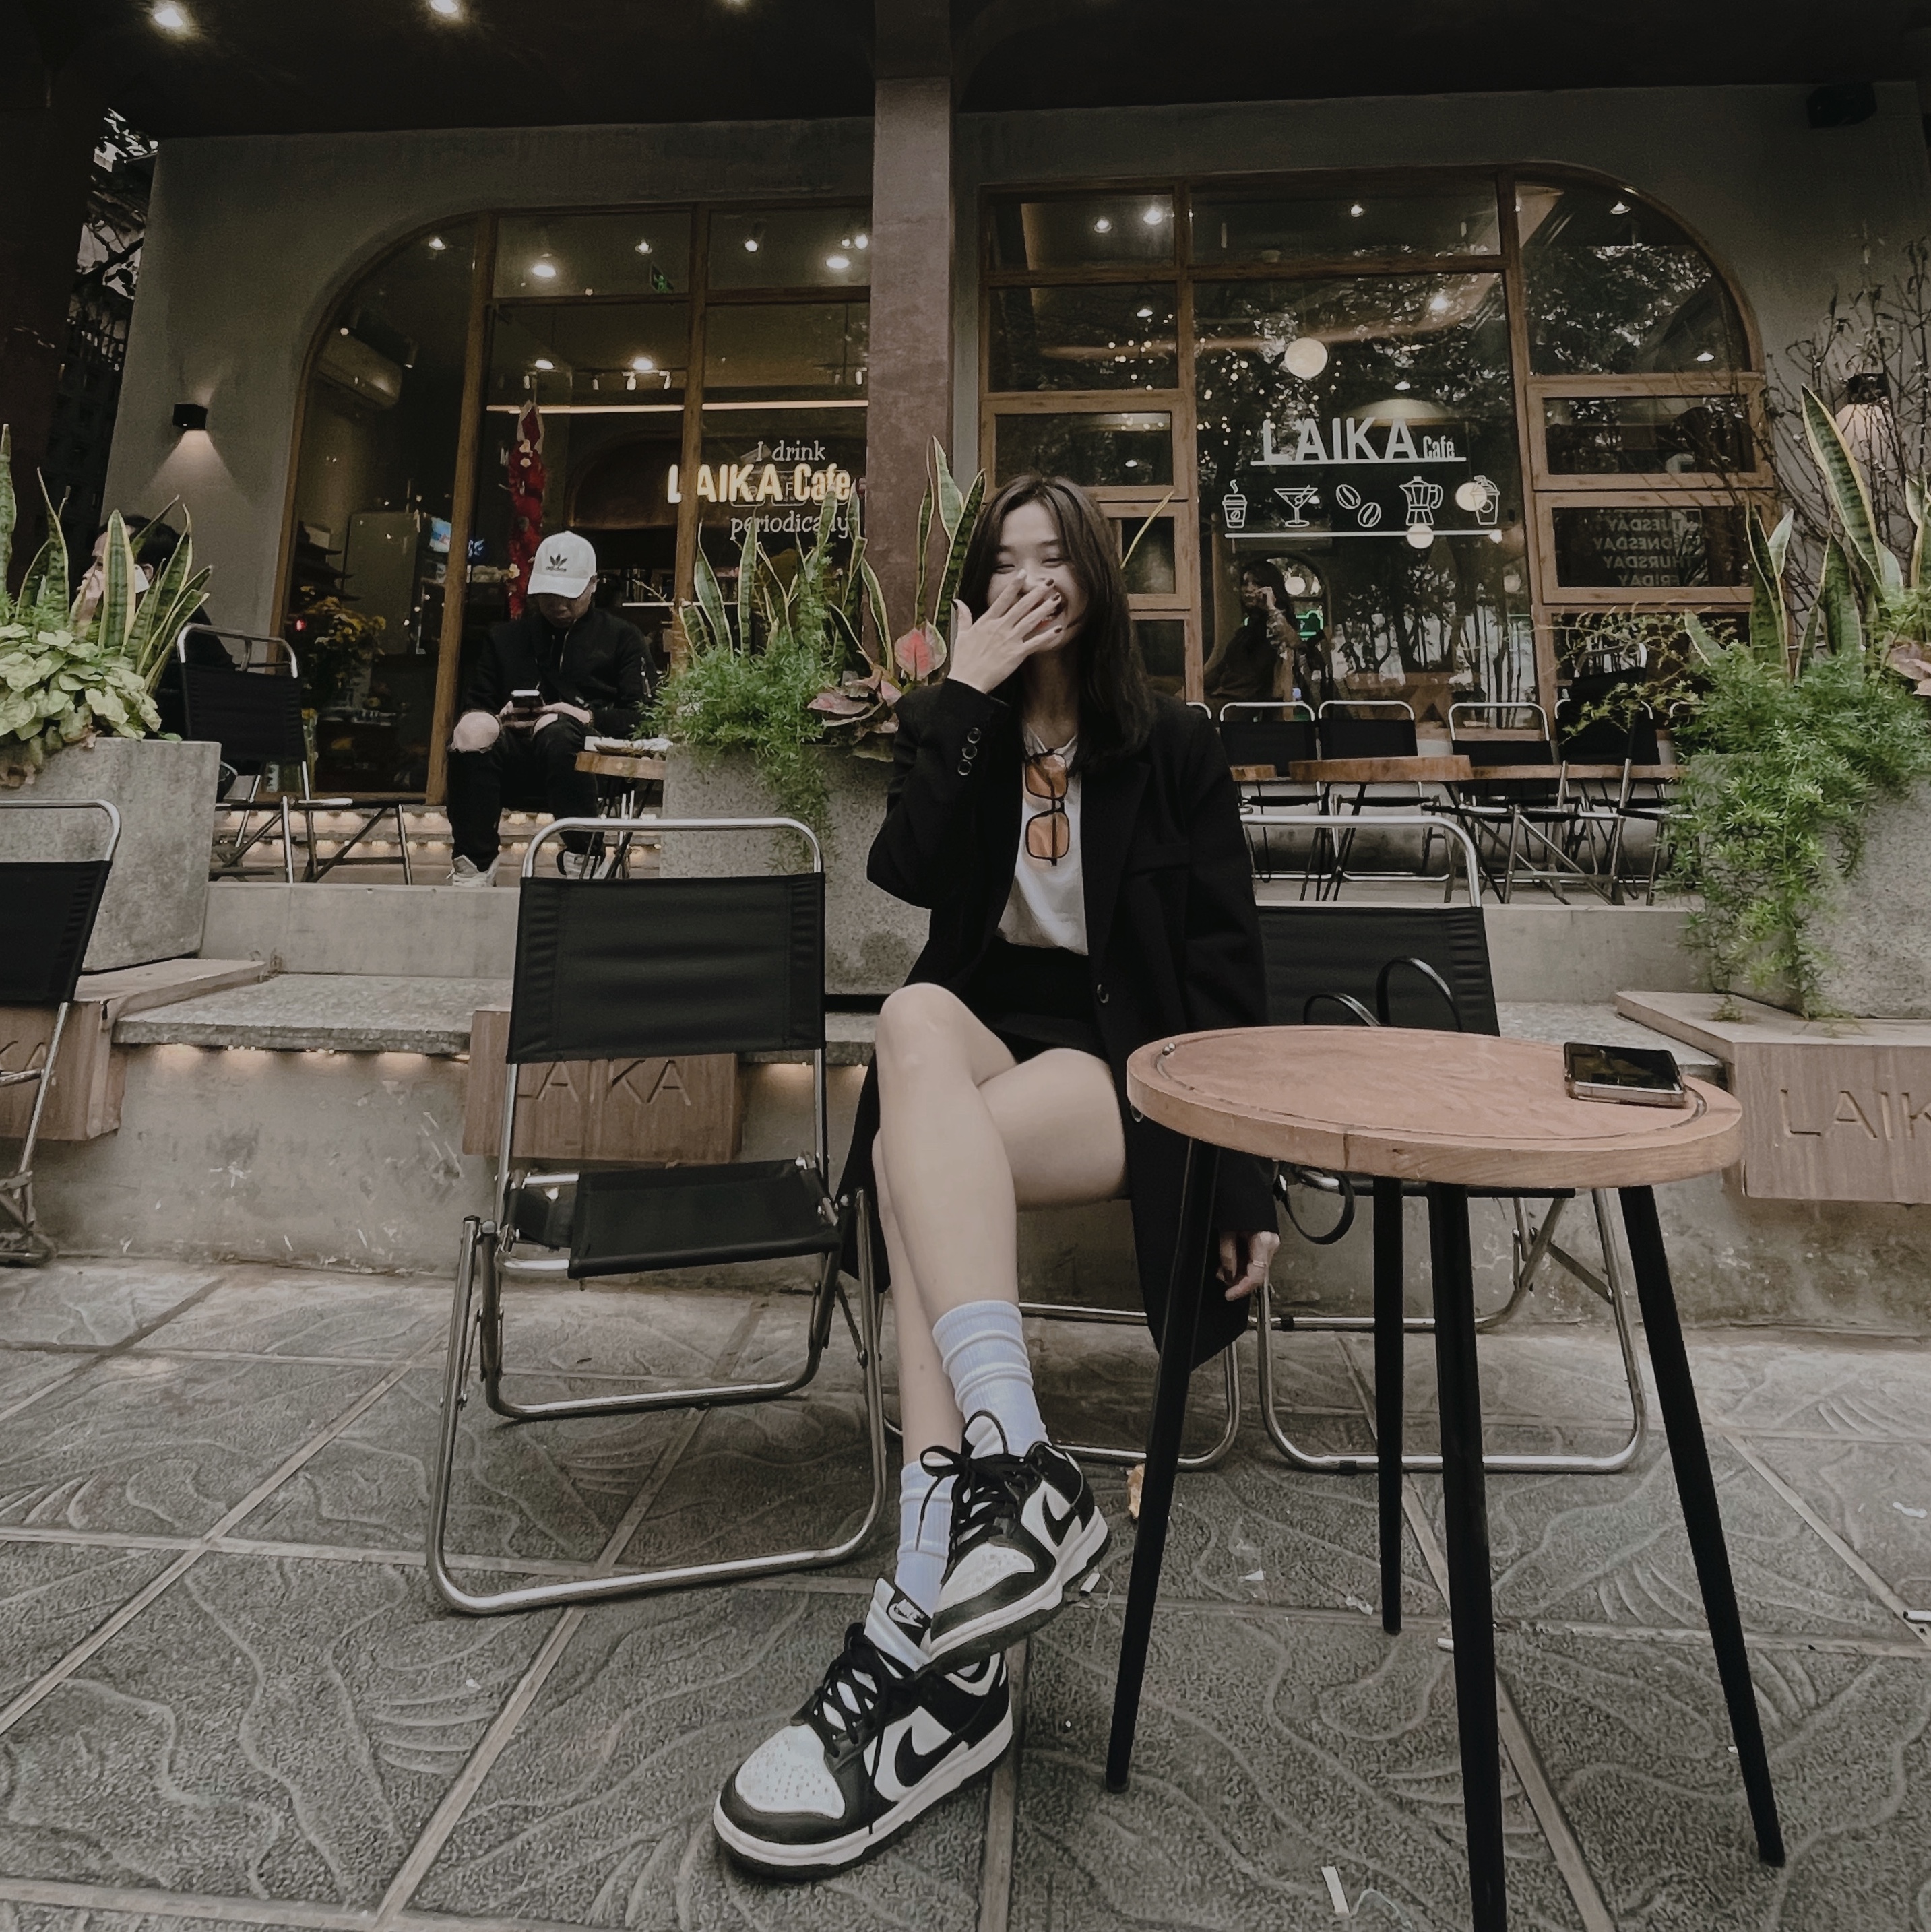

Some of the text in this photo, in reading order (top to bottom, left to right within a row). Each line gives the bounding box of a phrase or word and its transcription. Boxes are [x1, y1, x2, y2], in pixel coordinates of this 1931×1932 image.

[755, 439, 826, 462] I drink
[1263, 416, 1455, 461] LAIKA Café
[517, 1059, 691, 1106] AIKA
